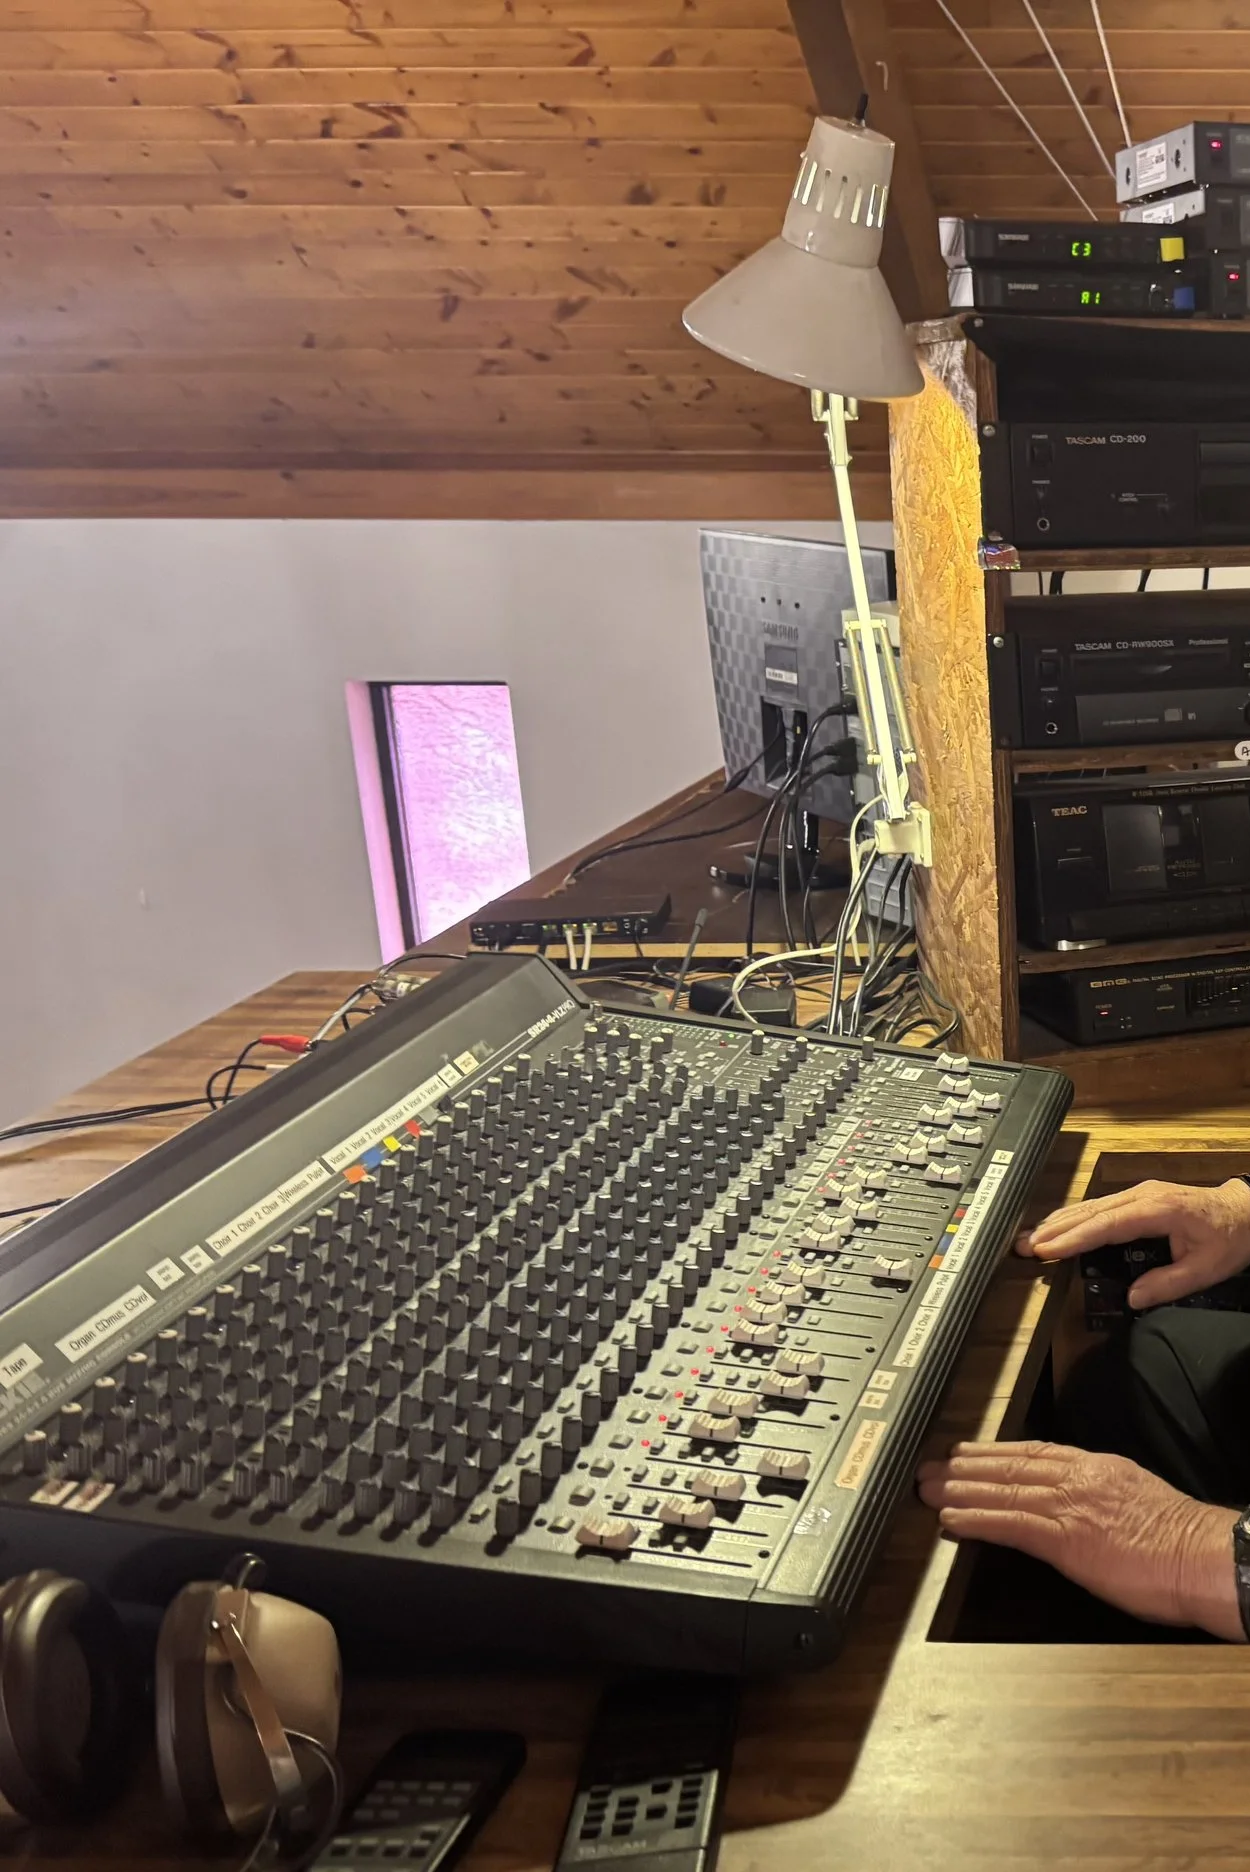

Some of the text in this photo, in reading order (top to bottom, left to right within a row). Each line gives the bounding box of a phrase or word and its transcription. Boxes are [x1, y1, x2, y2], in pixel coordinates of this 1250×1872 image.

[1071, 242, 1092, 257] C3
[1080, 291, 1101, 304] A1
[1064, 434, 1147, 446] TASCAM CD-200
[762, 620, 800, 642] SAMSUNG
[1074, 642, 1112, 652] TASCAM
[1051, 805, 1088, 817] TEAC
[68, 1331, 97, 1351] Organ
